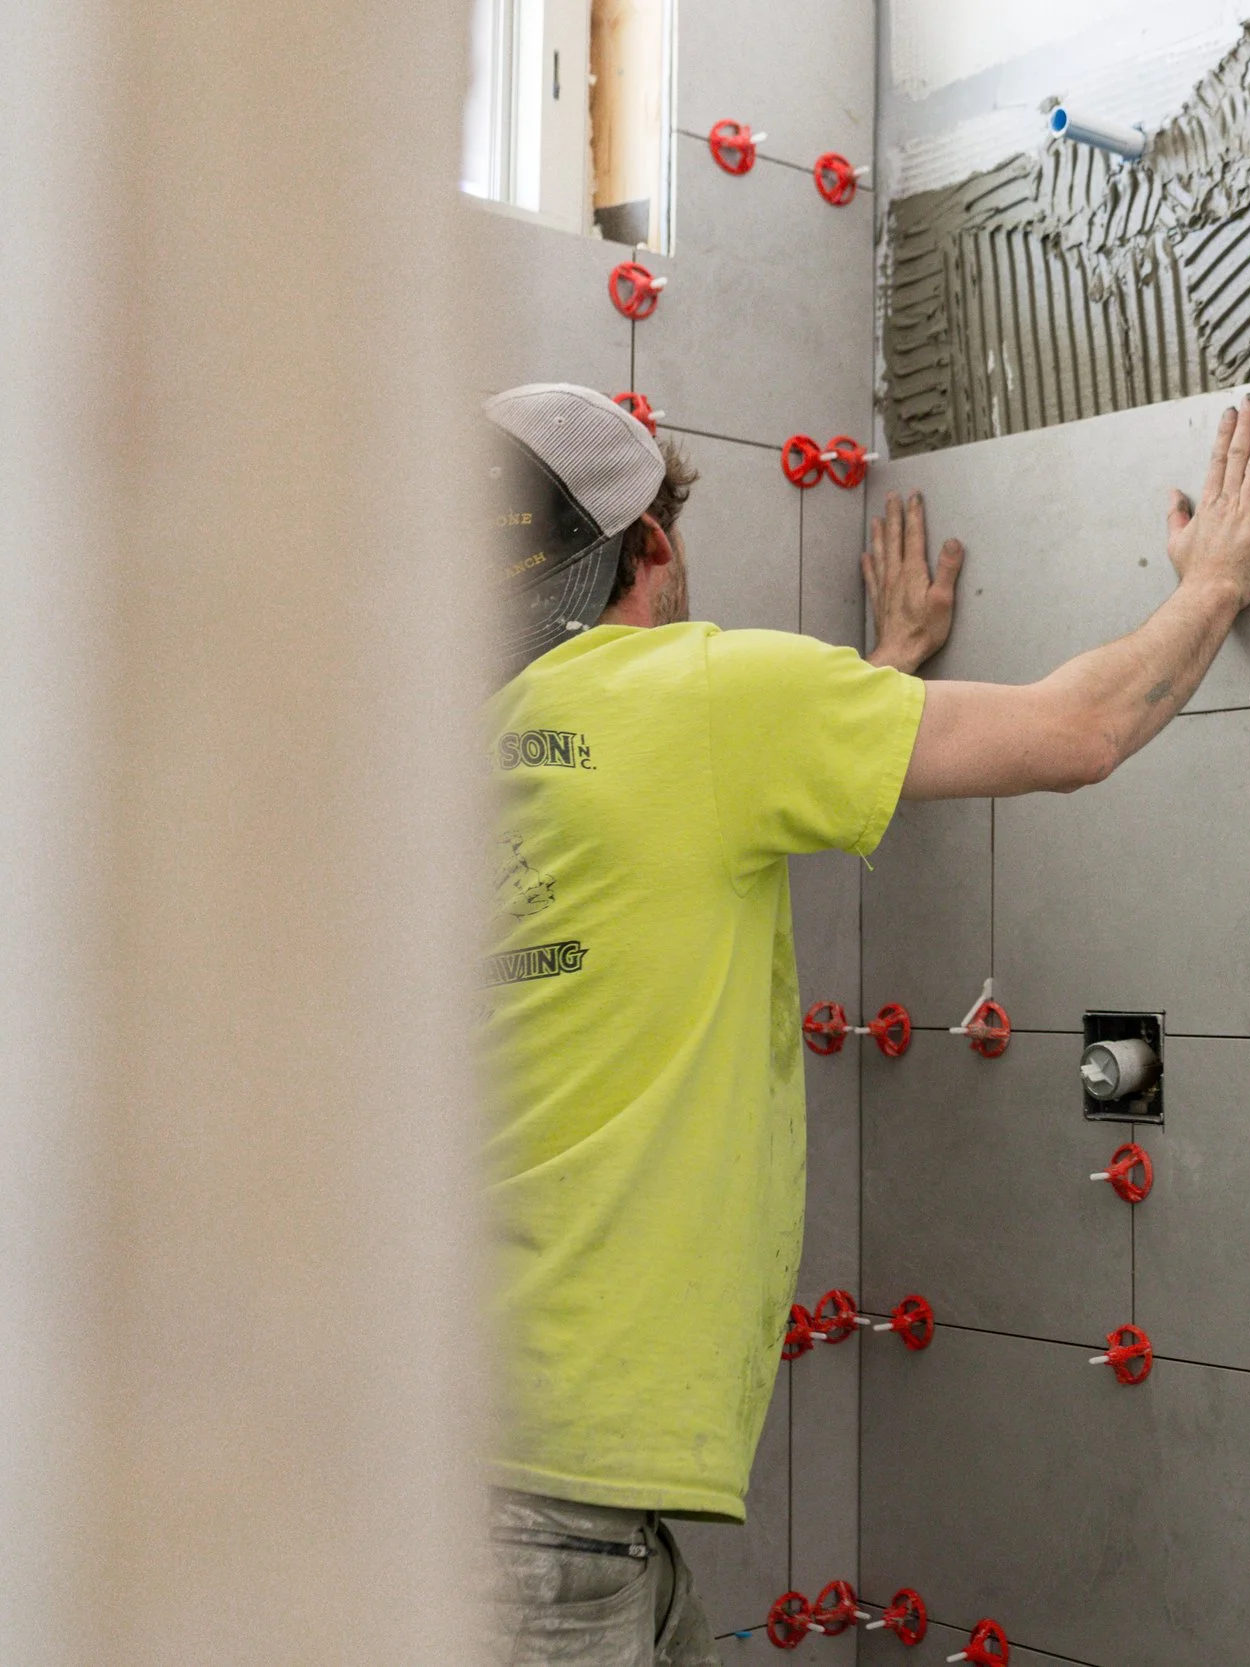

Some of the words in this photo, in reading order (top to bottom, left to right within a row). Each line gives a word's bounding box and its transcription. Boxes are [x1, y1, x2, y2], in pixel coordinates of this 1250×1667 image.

[497, 511, 533, 527] ONE
[505, 551, 546, 578] ANCH
[498, 729, 577, 771] SON
[483, 940, 589, 985] AVING
